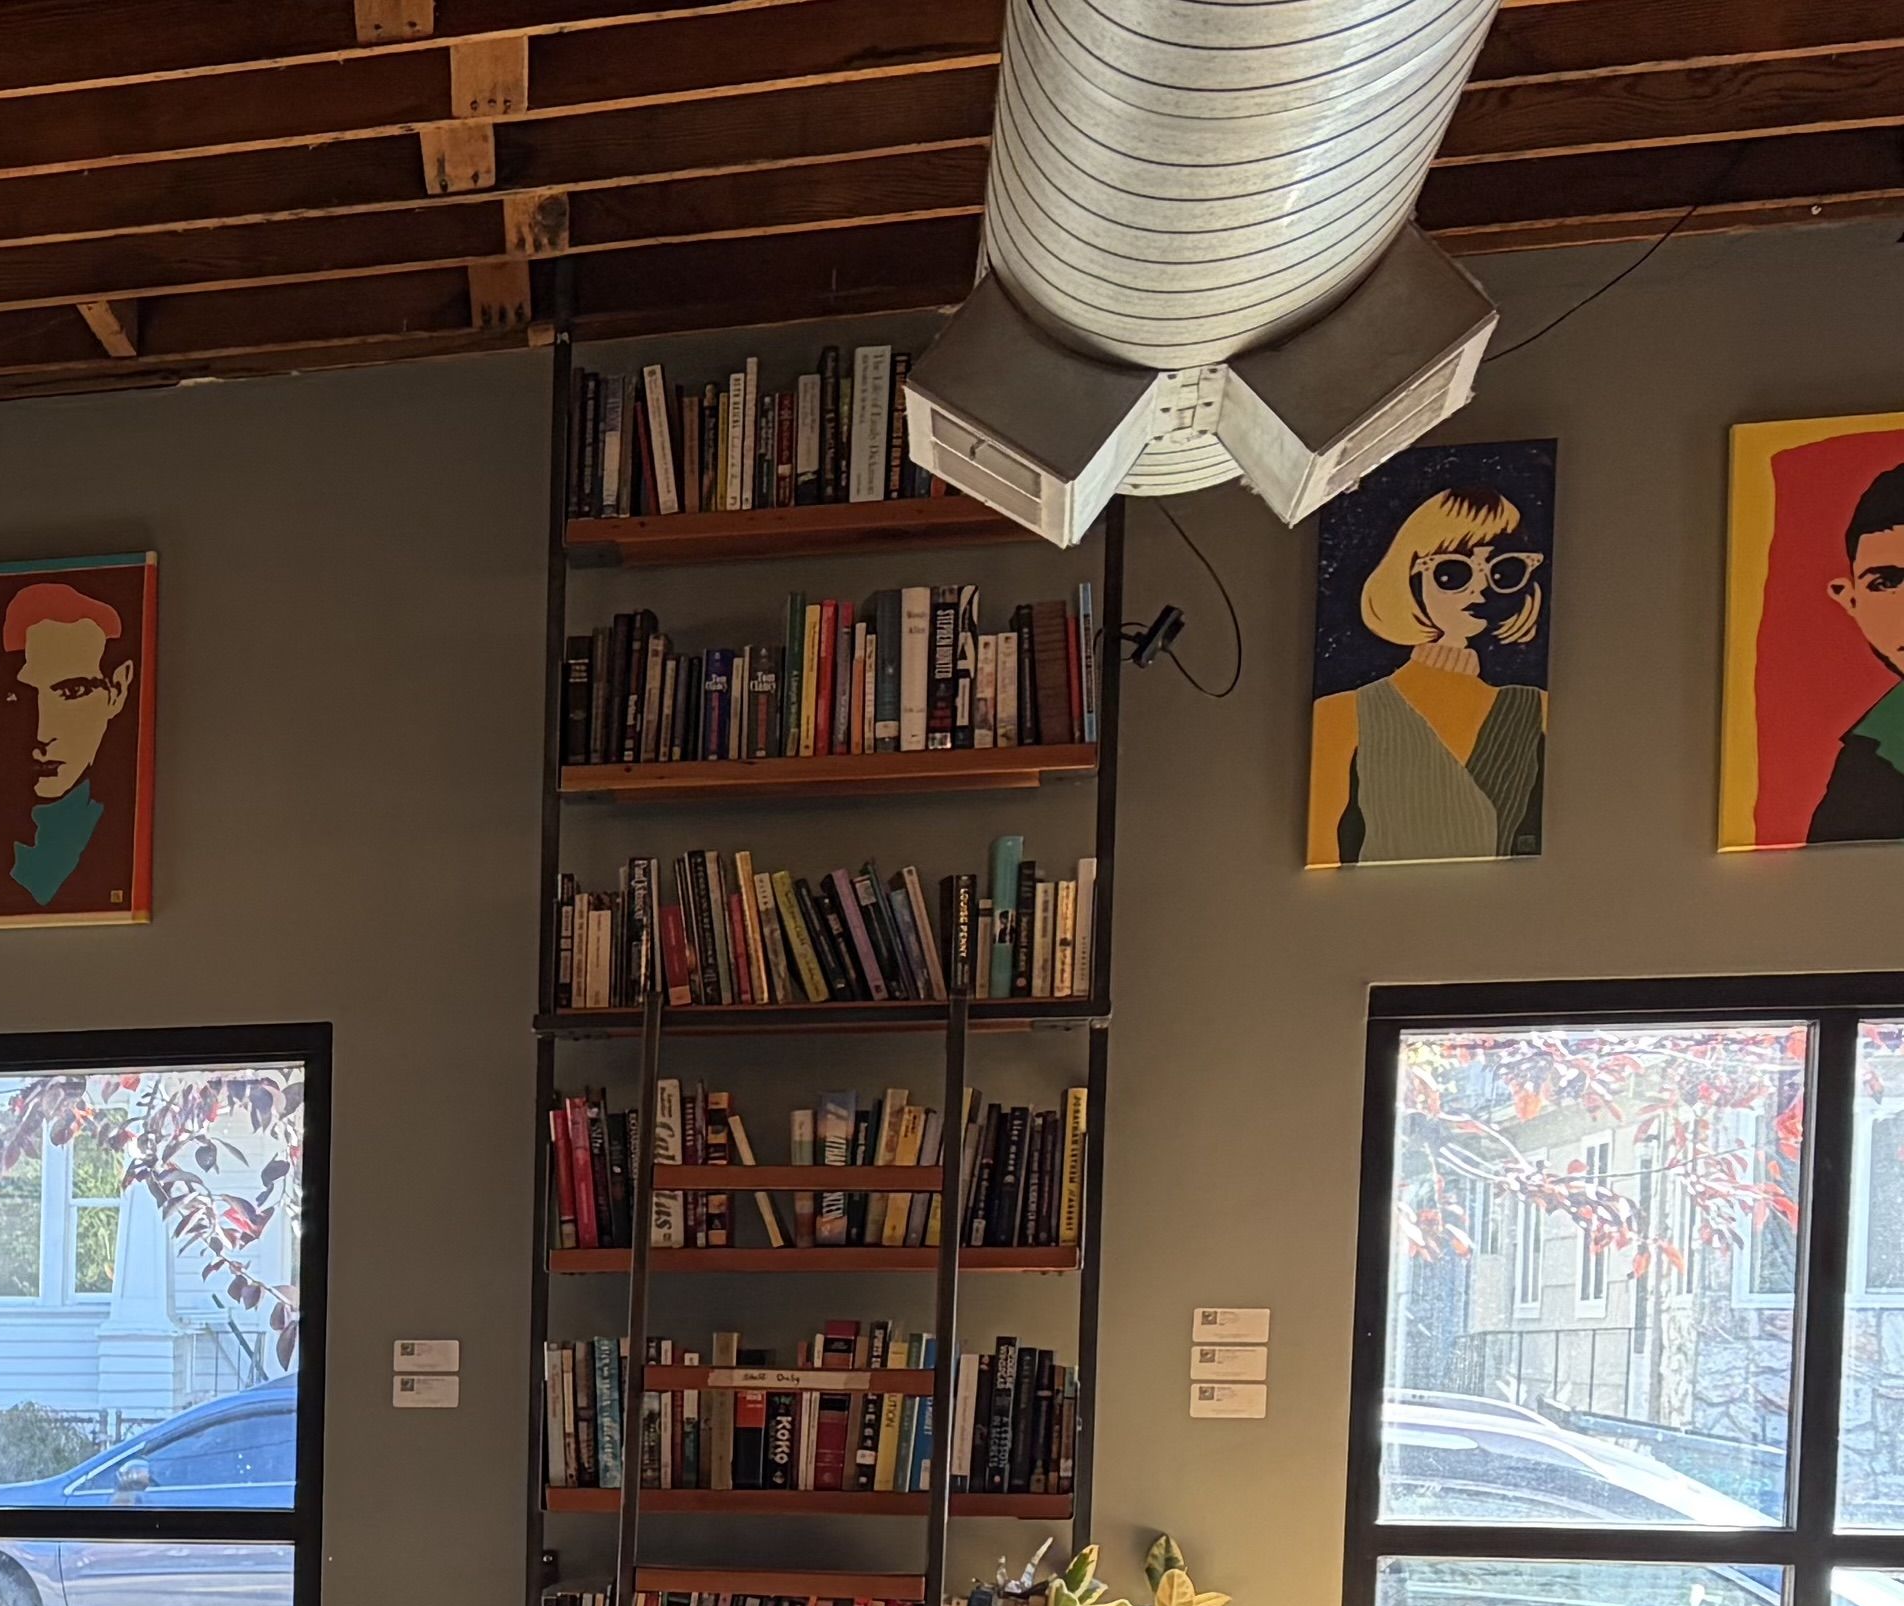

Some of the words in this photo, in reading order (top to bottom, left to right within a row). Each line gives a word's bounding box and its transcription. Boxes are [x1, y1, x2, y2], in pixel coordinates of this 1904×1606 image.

[871, 353, 885, 374] The
[870, 376, 884, 400] Life
[869, 401, 883, 410] of
[866, 444, 882, 496] Dickinson
[935, 609, 954, 645] STEPHEN
[711, 672, 727, 682] Tom
[756, 671, 775, 682] Tom
[934, 646, 953, 679] HUNTER
[705, 680, 727, 691] Clancy
[750, 680, 777, 691] Clancy
[959, 888, 970, 923] LOUISE
[958, 925, 969, 957] PENNY
[1071, 1096, 1082, 1145] JONATHAN
[885, 1393, 898, 1428] UTION
[773, 1415, 792, 1464] KOKO
